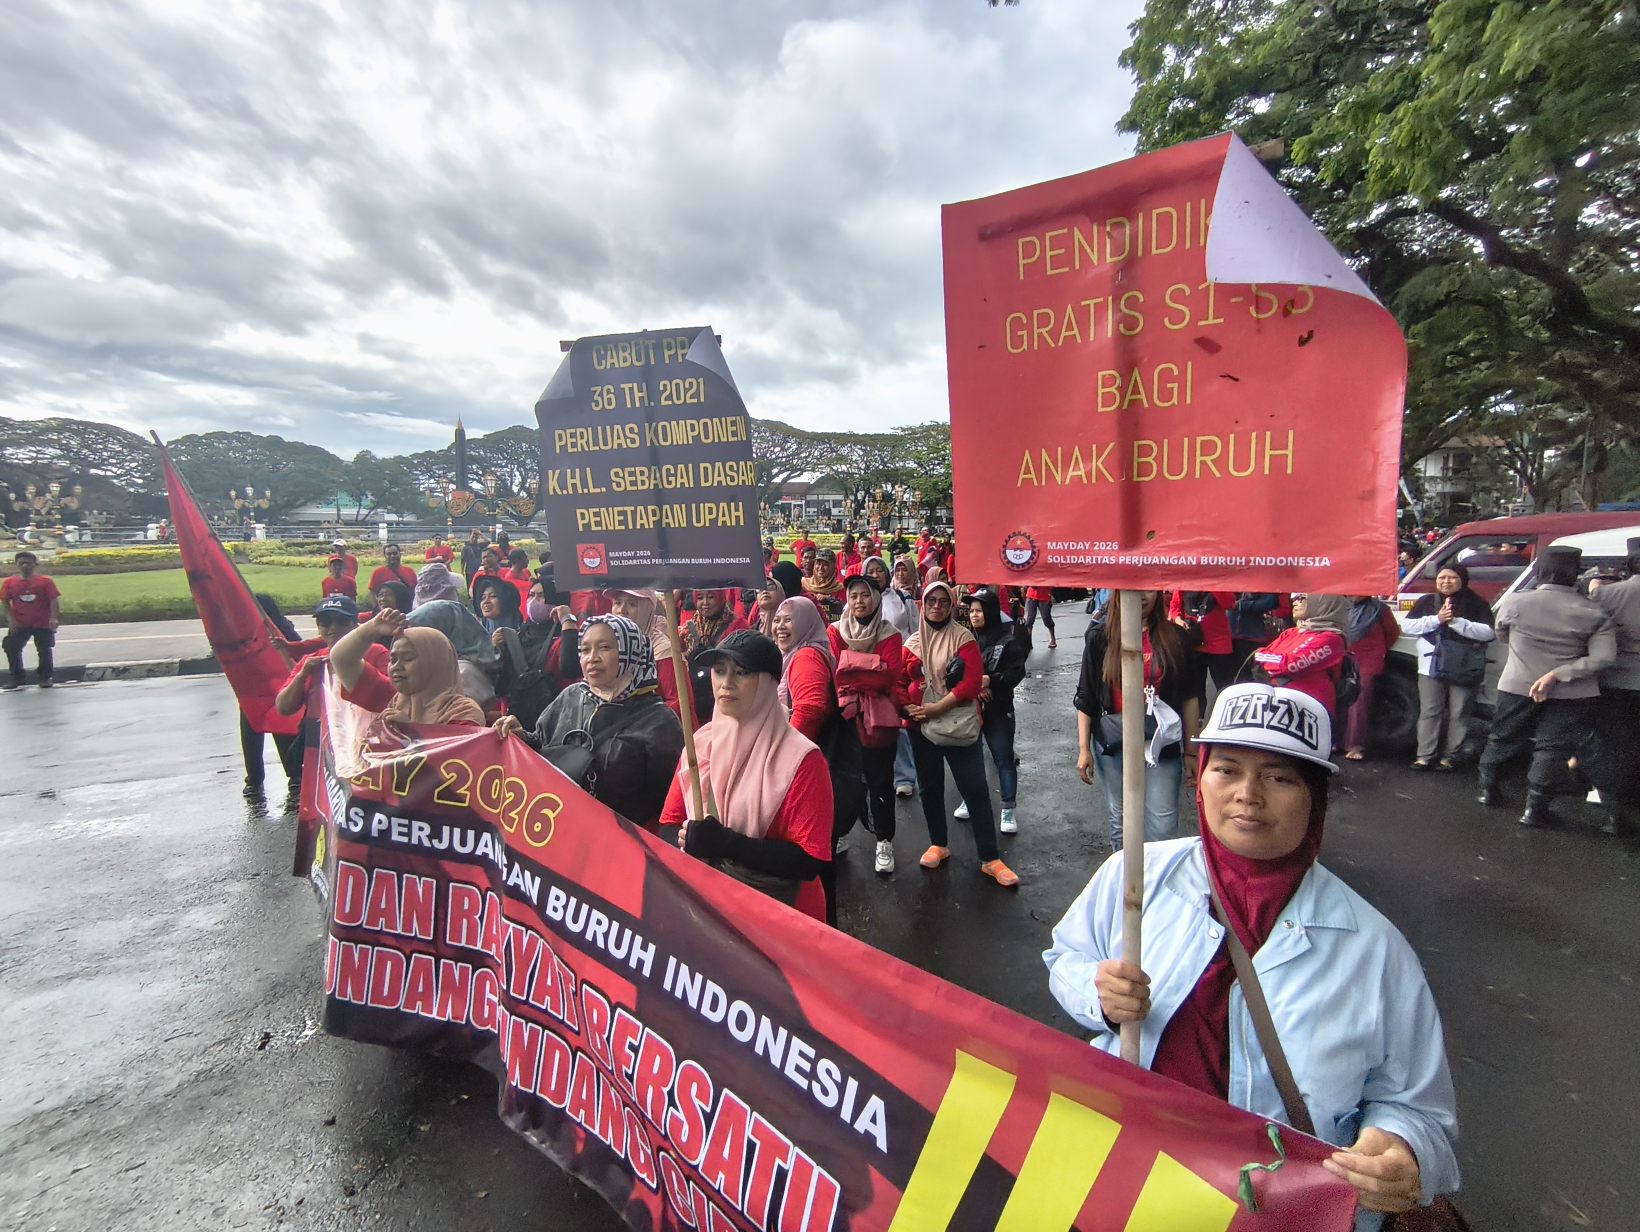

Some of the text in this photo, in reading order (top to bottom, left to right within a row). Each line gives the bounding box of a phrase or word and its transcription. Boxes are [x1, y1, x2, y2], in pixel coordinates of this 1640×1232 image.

[1005, 290, 1144, 354] GRATIS
[592, 336, 688, 371] CABUT PP
[590, 377, 705, 411] 36 TH. 2021
[1097, 361, 1192, 413] BAGI
[554, 415, 747, 454] PERLUAS KOMPONEN
[1016, 429, 1295, 488] ANAK BURUH
[547, 461, 756, 495] K.H.L. SEBAGAI DASAR
[576, 502, 744, 532] PENETAPAN UPAH
[652, 558, 690, 566] PERJUANGAN
[713, 557, 751, 565] INDONESIA
[1047, 541, 1119, 551] MAYDAY 2026
[1047, 554, 1331, 567] SOLIDARITAS PERJUANGAN BURUH INDONESIA
[1287, 645, 1333, 673] adidas
[435, 758, 564, 848] 2026
[545, 885, 657, 978] BURUH
[662, 954, 888, 1153] INDONESIA
[334, 861, 437, 941] DAN
[581, 983, 841, 1232] BERSATU
